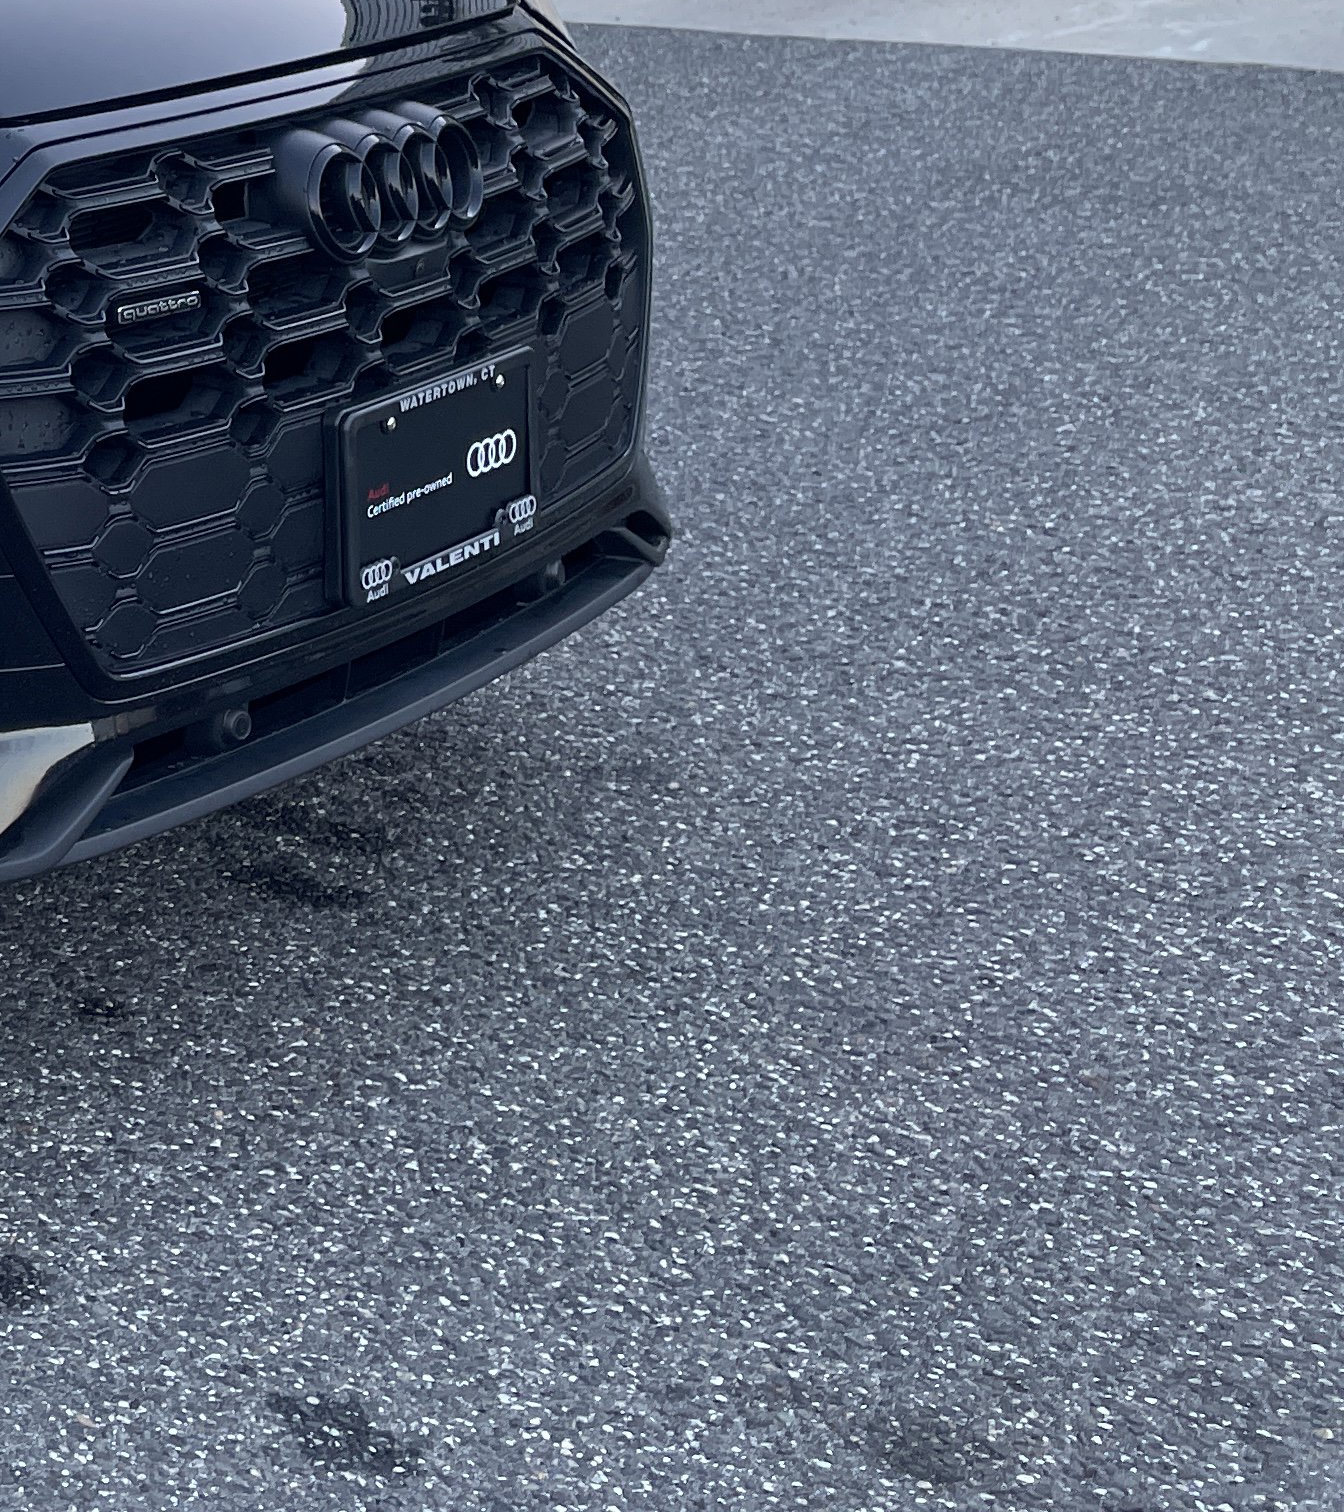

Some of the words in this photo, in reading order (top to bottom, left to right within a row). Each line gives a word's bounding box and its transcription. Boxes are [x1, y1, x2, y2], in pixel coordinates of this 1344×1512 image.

[123, 294, 199, 322] quattro
[399, 373, 478, 413] WATERTOWN,
[481, 364, 496, 381] CT
[367, 491, 405, 518] Certified
[406, 471, 453, 504] pre-owned
[368, 482, 390, 500] Audi
[514, 518, 534, 536] Audi
[404, 531, 501, 585] VALENTI
[366, 584, 389, 603] Audi
